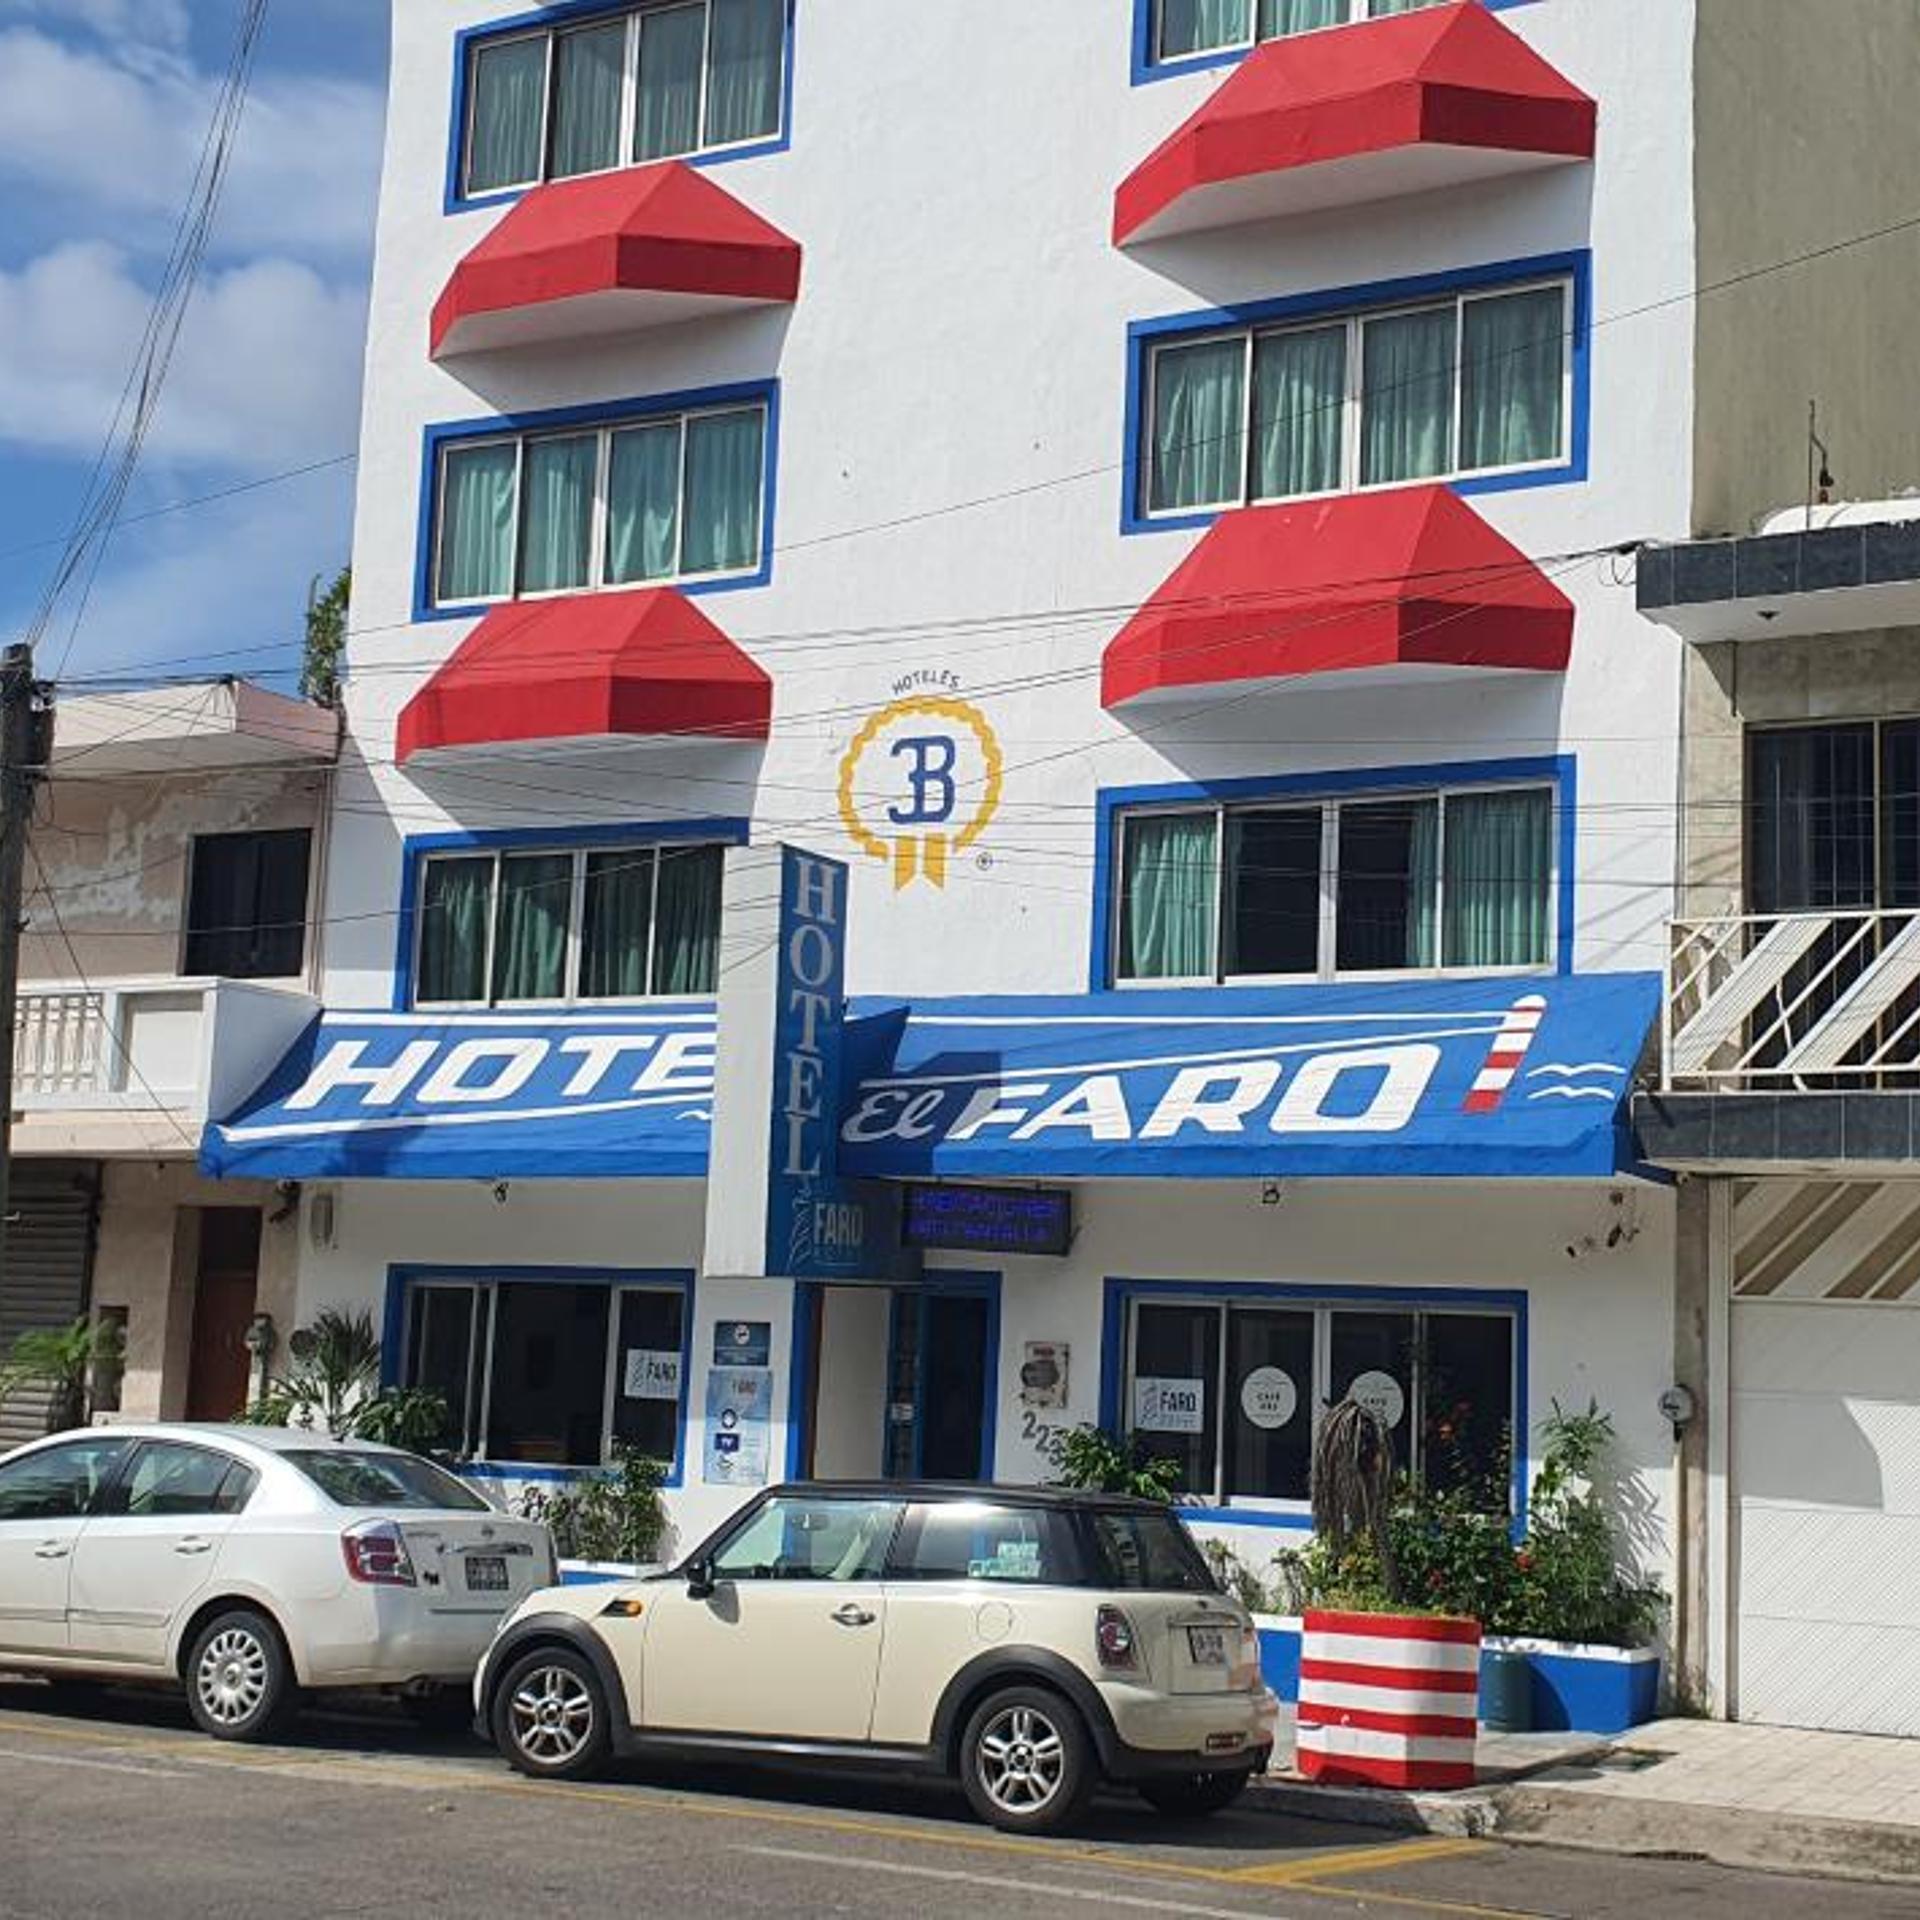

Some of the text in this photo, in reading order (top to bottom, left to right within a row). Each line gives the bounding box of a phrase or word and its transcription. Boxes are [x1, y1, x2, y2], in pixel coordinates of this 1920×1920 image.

[891, 670, 961, 696] HOTELES
[782, 856, 839, 1176] HOTEL
[282, 1032, 717, 1110] HOTE
[841, 1043, 1440, 1142] El FARO
[814, 1202, 864, 1247] FARO
[1161, 1391, 1197, 1412] FARO
